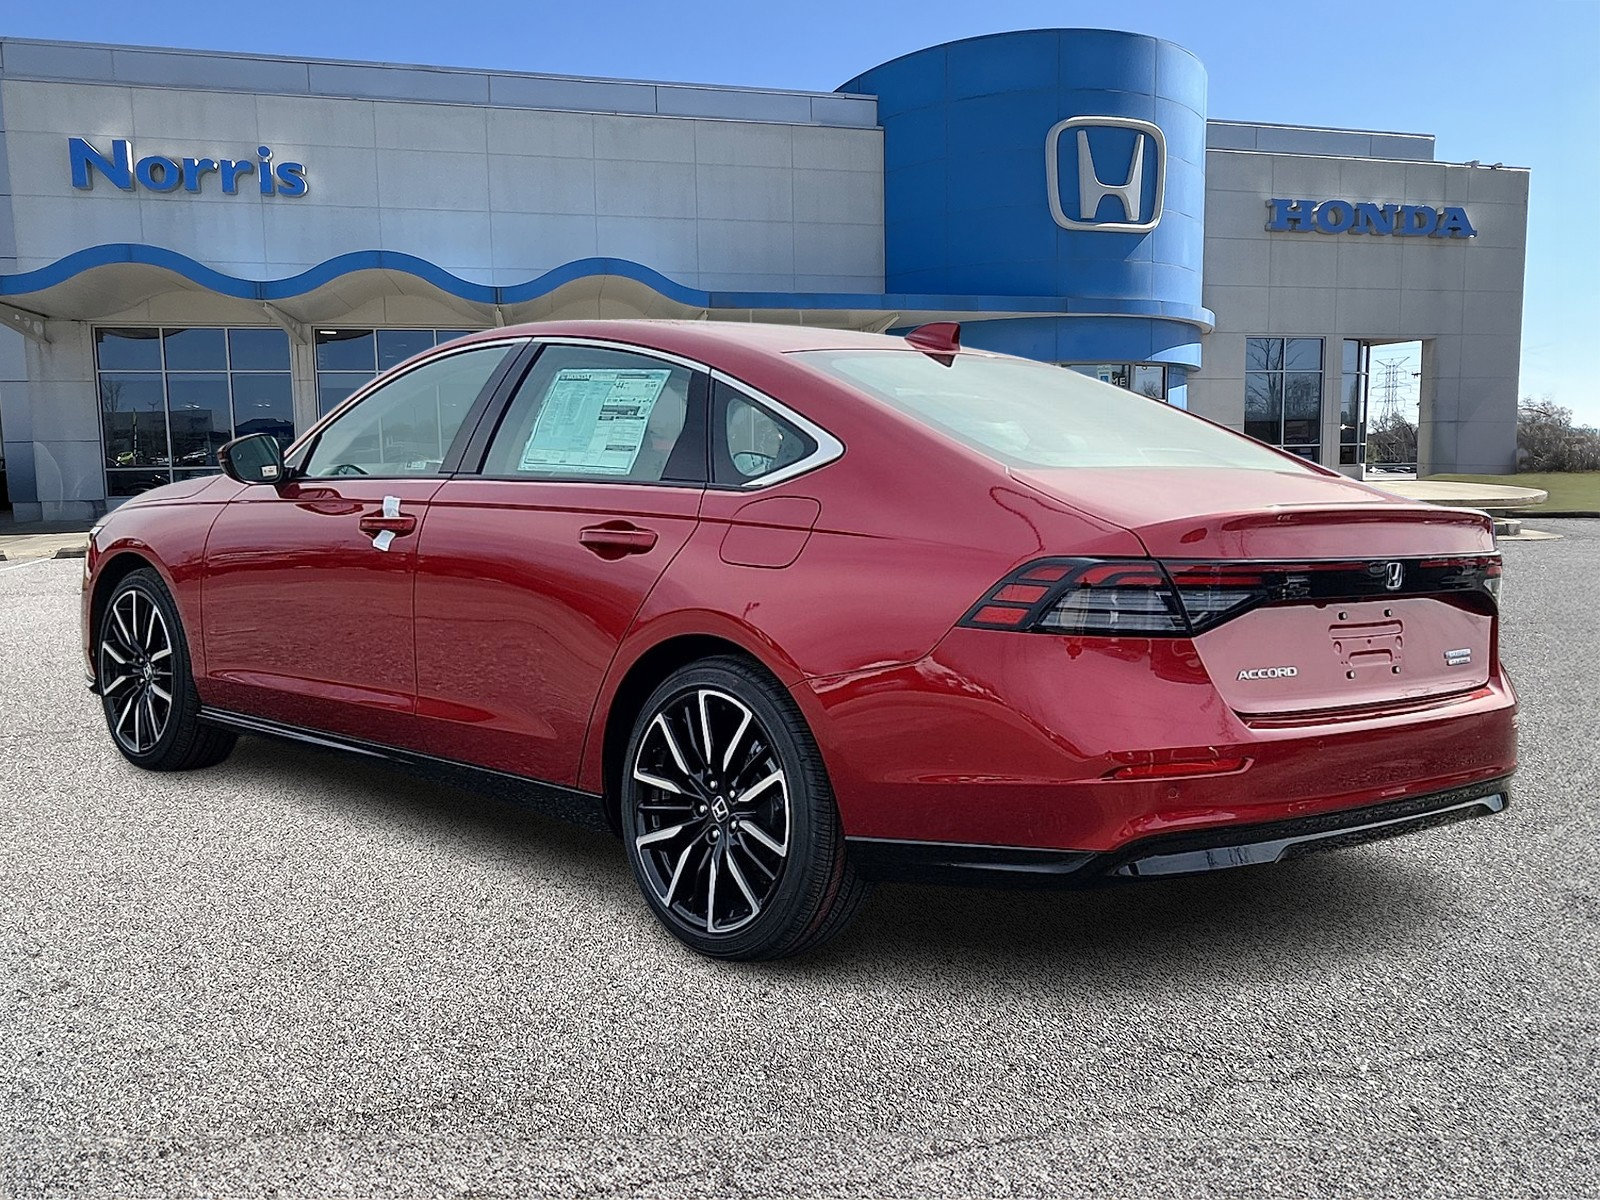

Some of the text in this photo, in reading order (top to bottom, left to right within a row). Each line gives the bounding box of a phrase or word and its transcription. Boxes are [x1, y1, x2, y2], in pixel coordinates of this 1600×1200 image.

[68, 137, 309, 198] Norris
[1265, 198, 1478, 240] HONDA
[1236, 665, 1298, 681] ACCORD
